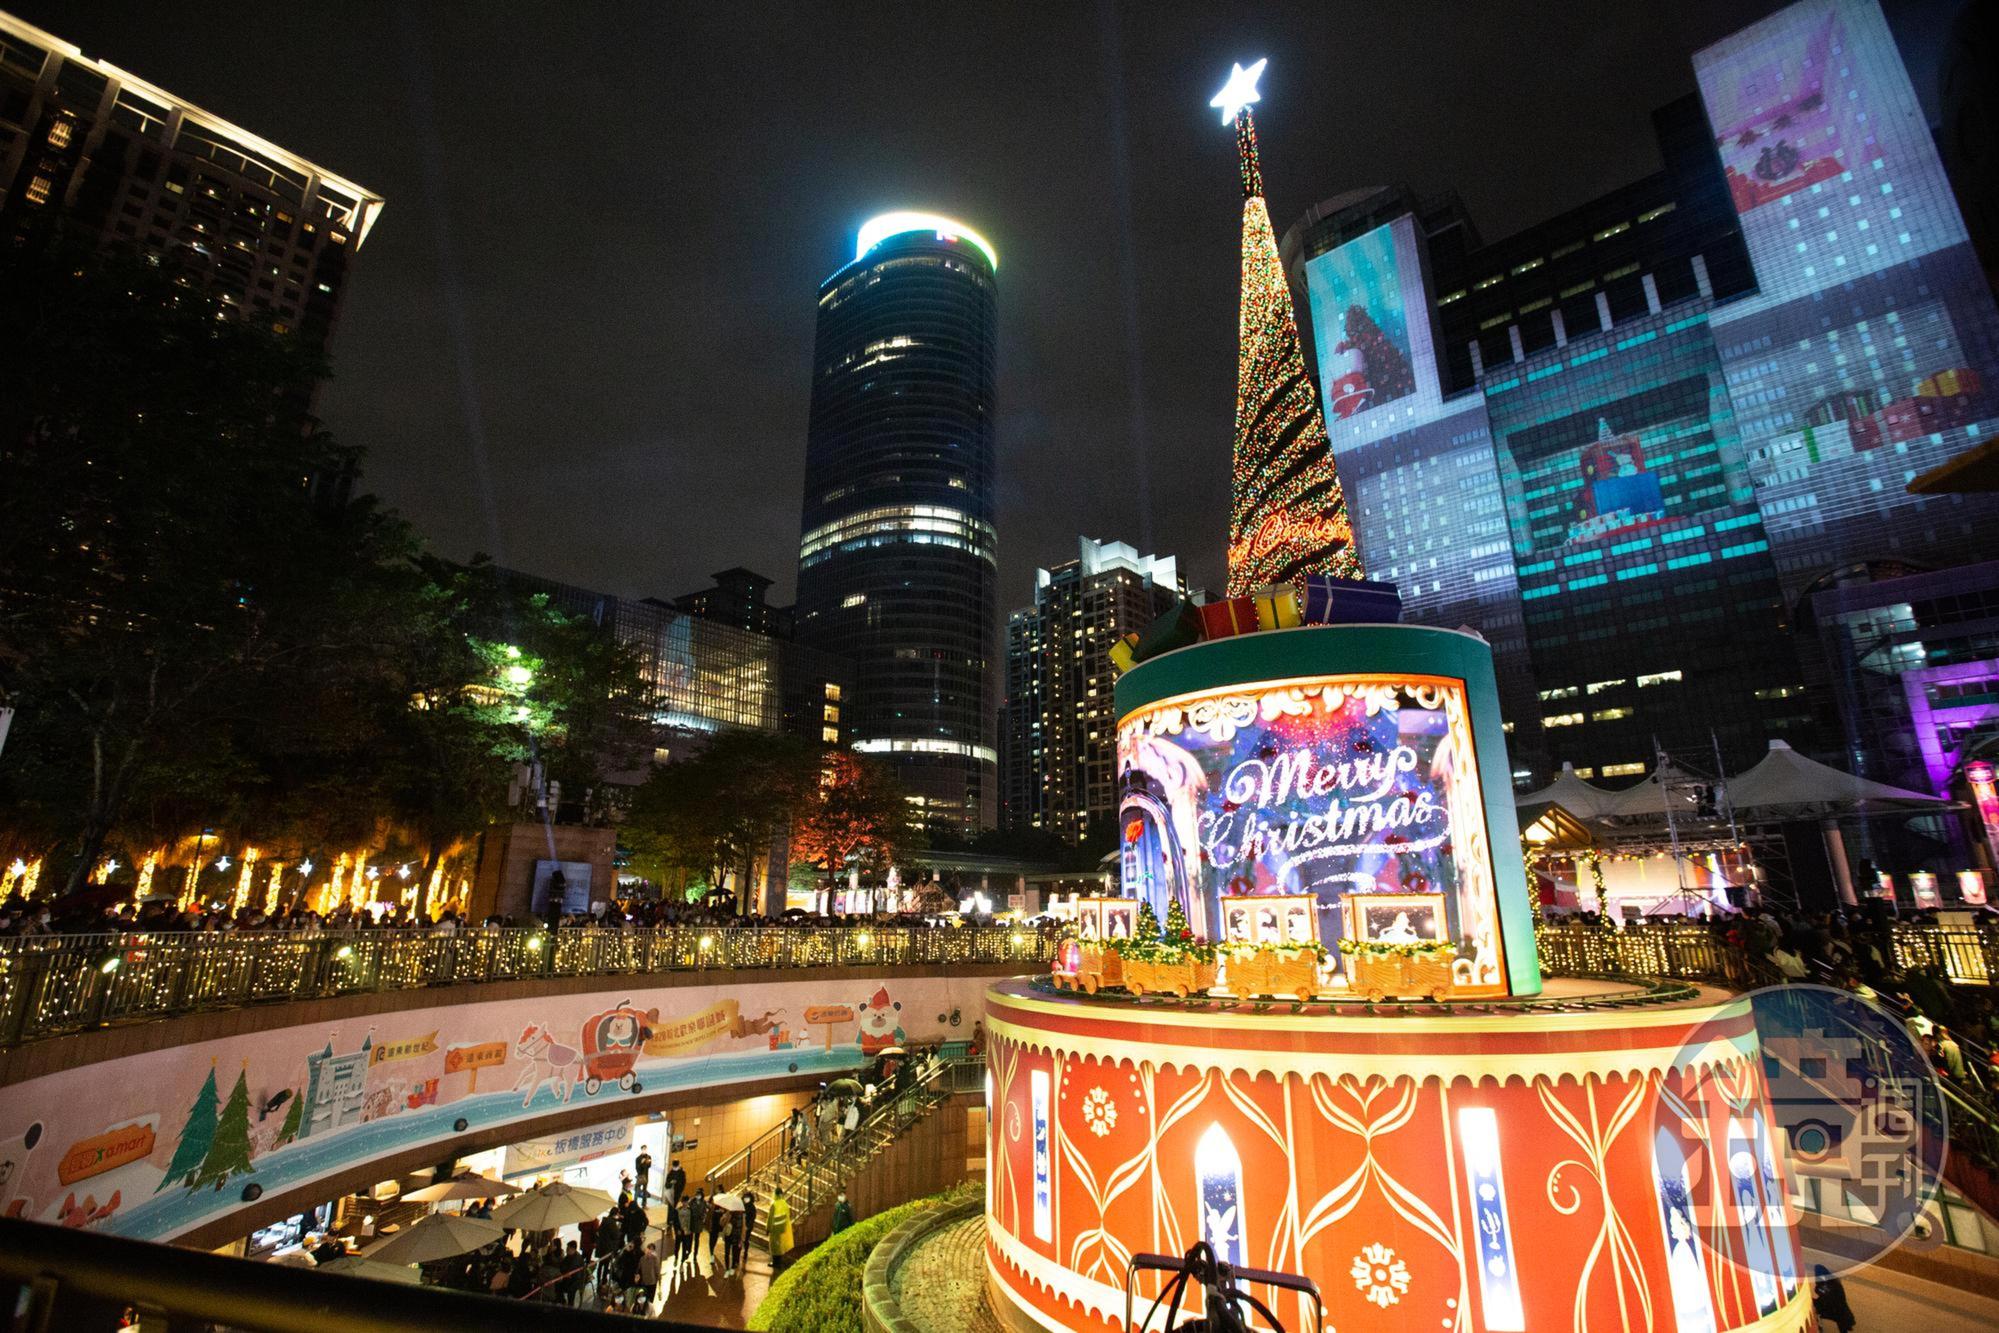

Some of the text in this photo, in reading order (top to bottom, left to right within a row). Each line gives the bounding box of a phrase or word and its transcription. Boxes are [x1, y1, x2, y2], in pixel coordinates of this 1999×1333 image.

[1225, 746, 1418, 808] Merry
[1196, 790, 1450, 870] Christmas
[554, 1126, 627, 1155] 板橋服務中心
